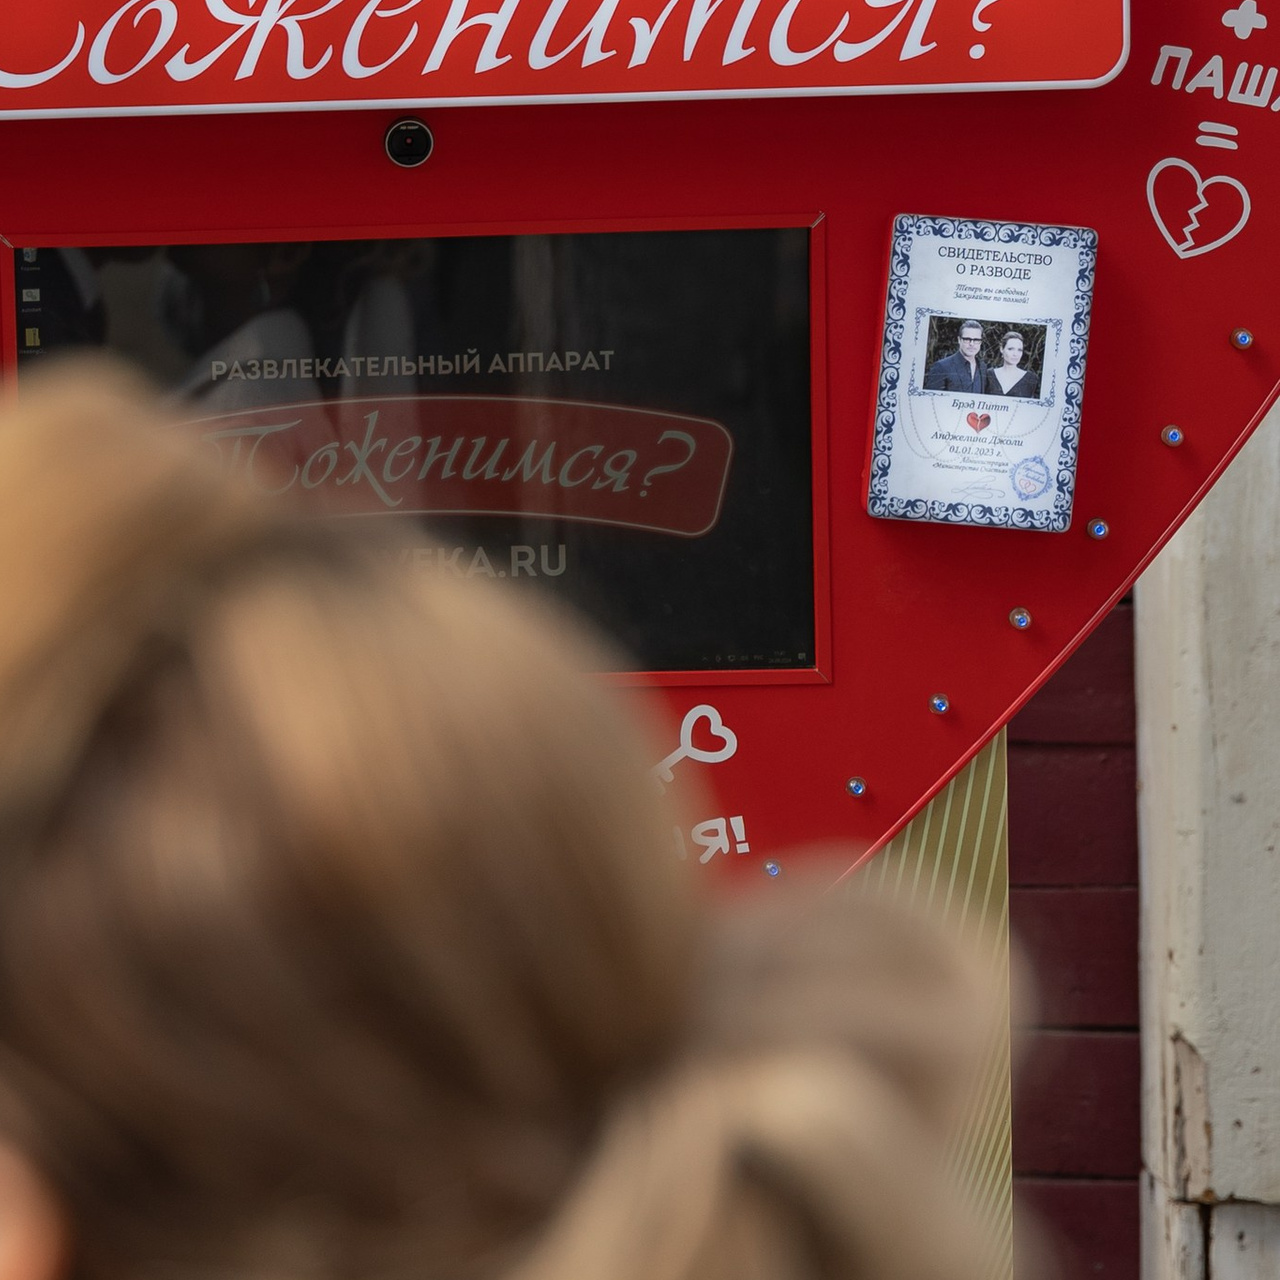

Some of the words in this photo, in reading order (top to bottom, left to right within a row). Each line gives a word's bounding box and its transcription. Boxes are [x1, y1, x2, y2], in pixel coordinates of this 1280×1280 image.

[1150, 44, 1280, 112] ПАШ
[938, 246, 1053, 266] СВИДЕТЕЛЬСТВО
[956, 263, 966, 275] О
[970, 264, 1032, 280] РАЗВОДЕ
[955, 283, 983, 294] Теперь
[994, 286, 1029, 297] свободны!
[210, 347, 482, 381] РАЗВЛЕКАТЕЛЬНЫЙ
[486, 348, 616, 375] АППАРАТ
[951, 399, 976, 410] Брэд
[977, 401, 1010, 412] Питт
[930, 431, 987, 443] Анджелина
[988, 436, 1024, 447] Джоли
[948, 445, 994, 456] 01.01.2023
